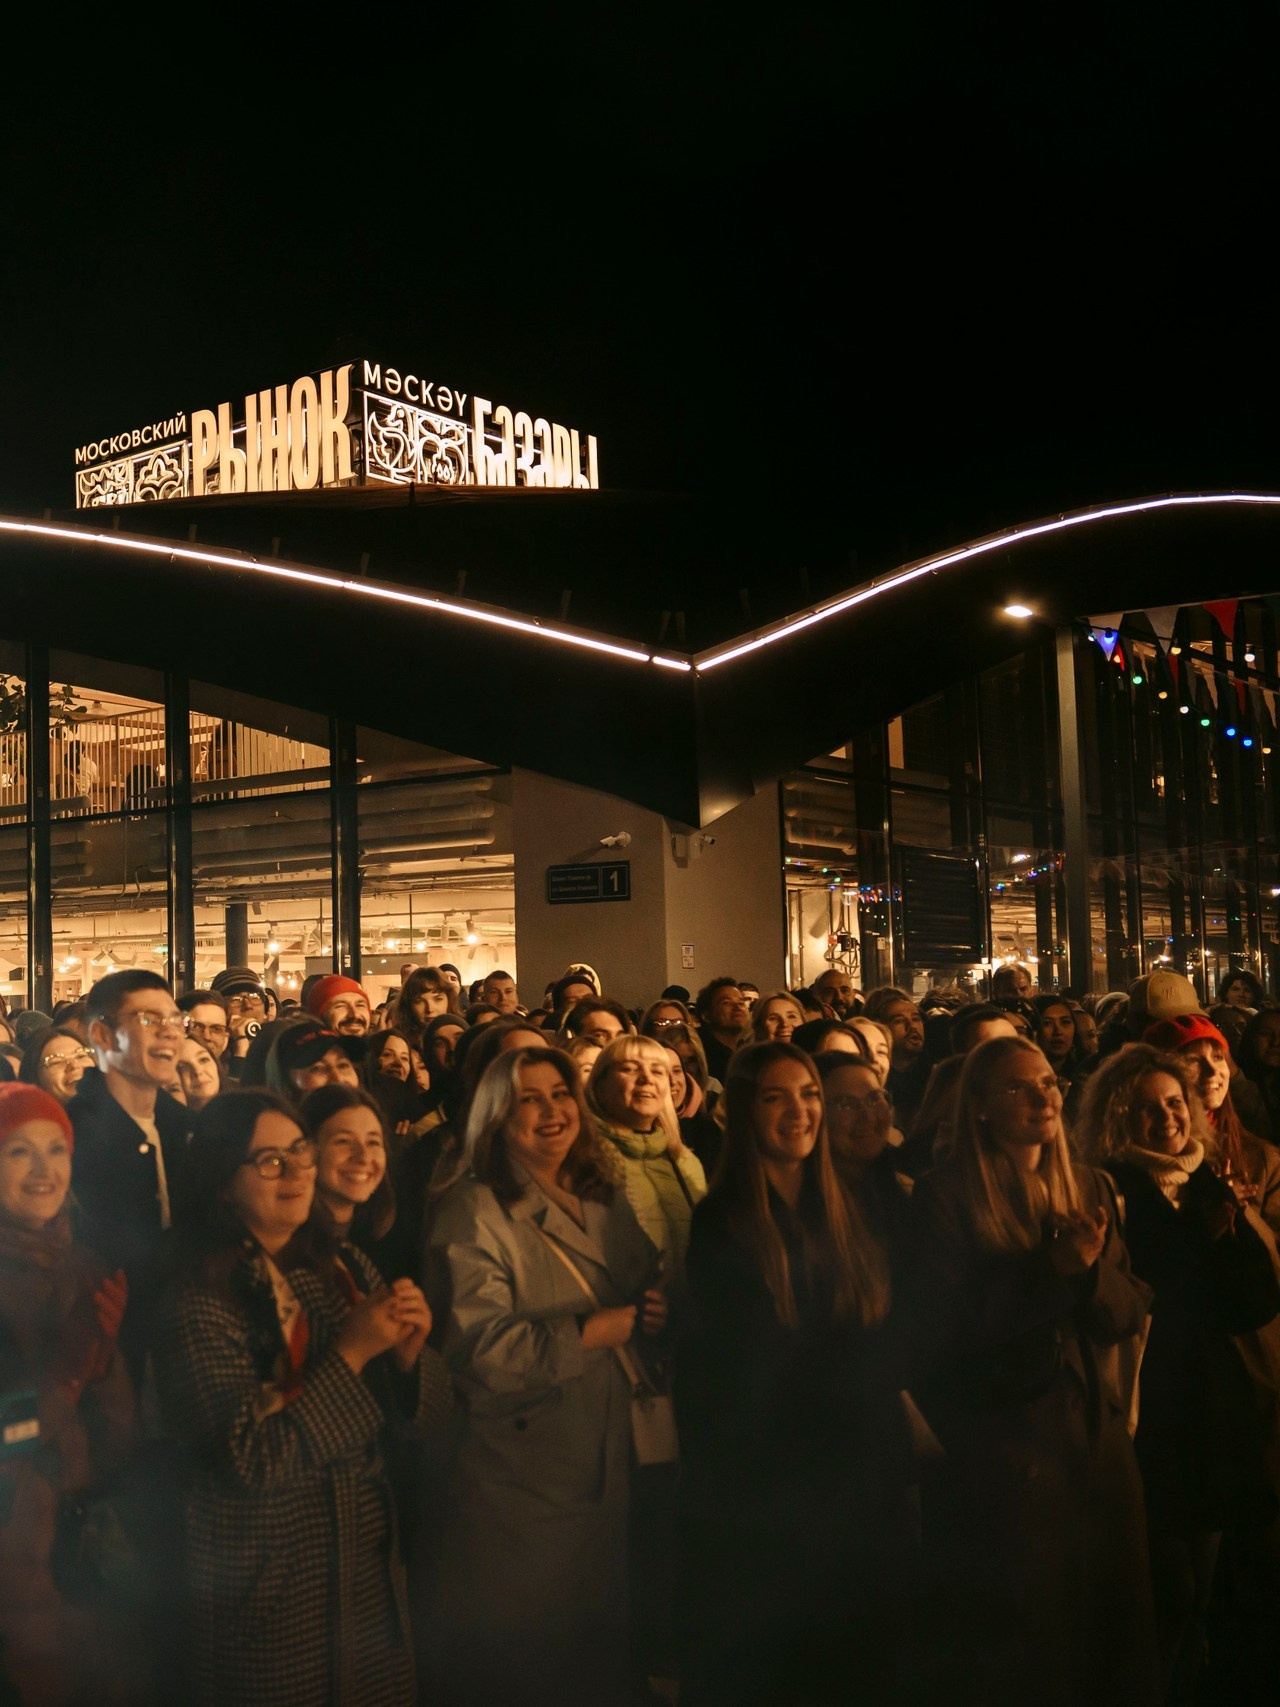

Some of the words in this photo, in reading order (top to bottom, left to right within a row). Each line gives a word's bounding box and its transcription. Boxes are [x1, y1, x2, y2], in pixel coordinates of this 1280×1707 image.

[75, 411, 187, 465] МОСКОВСКИЙ
[192, 364, 358, 496] РЫНОК
[609, 870, 619, 892] 1
